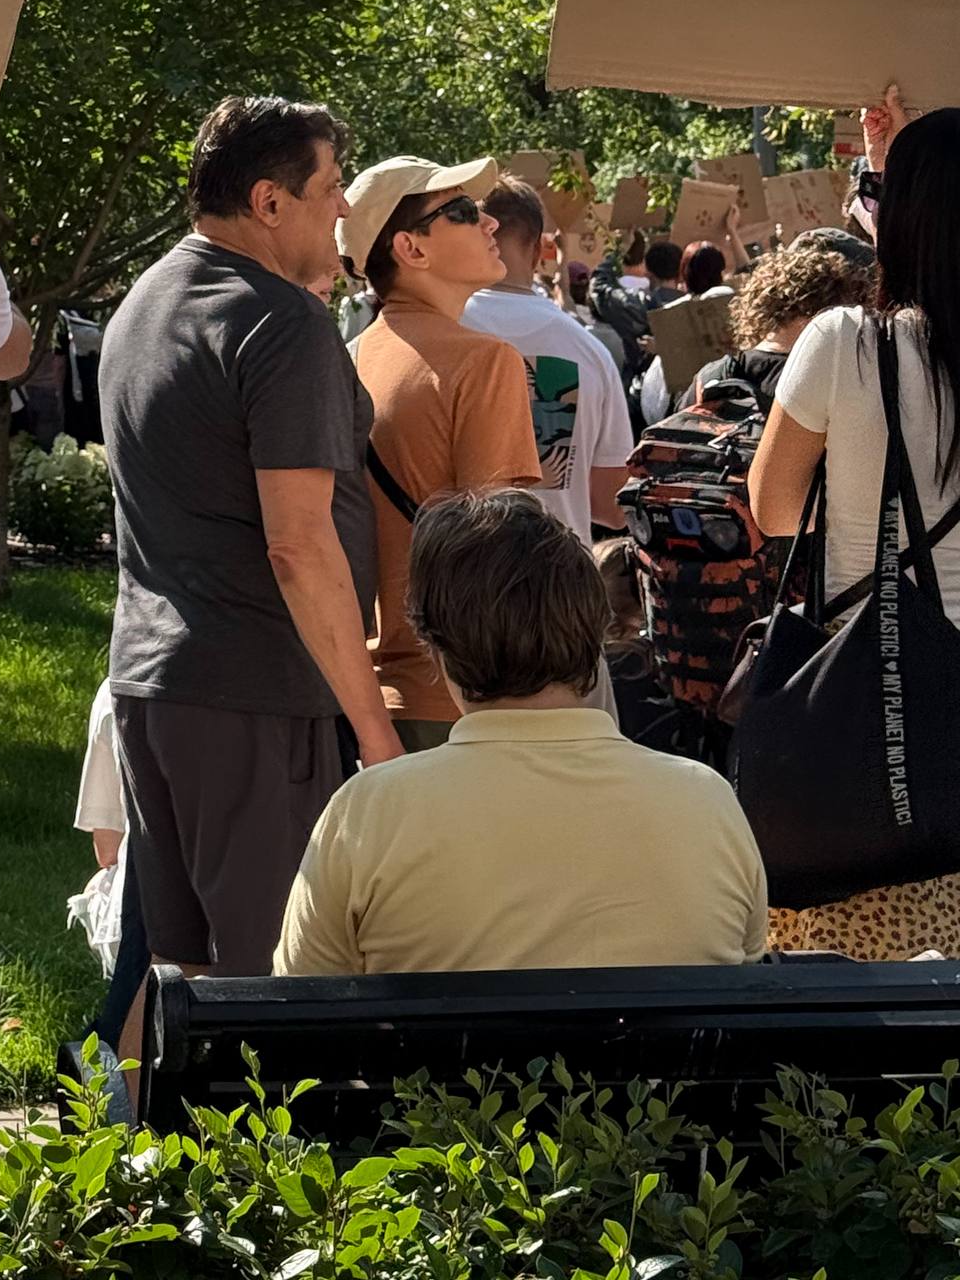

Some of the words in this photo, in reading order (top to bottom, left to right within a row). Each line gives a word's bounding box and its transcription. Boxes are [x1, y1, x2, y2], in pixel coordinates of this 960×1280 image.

[883, 511, 899, 530] MY
[881, 534, 900, 579] PLANET
[879, 581, 899, 599] NO
[879, 603, 901, 657] PLASTIC!
[882, 673, 902, 694] MY
[883, 696, 905, 742] PLANET
[886, 746, 906, 765] NO
[888, 767, 913, 826] PLASTIC!
